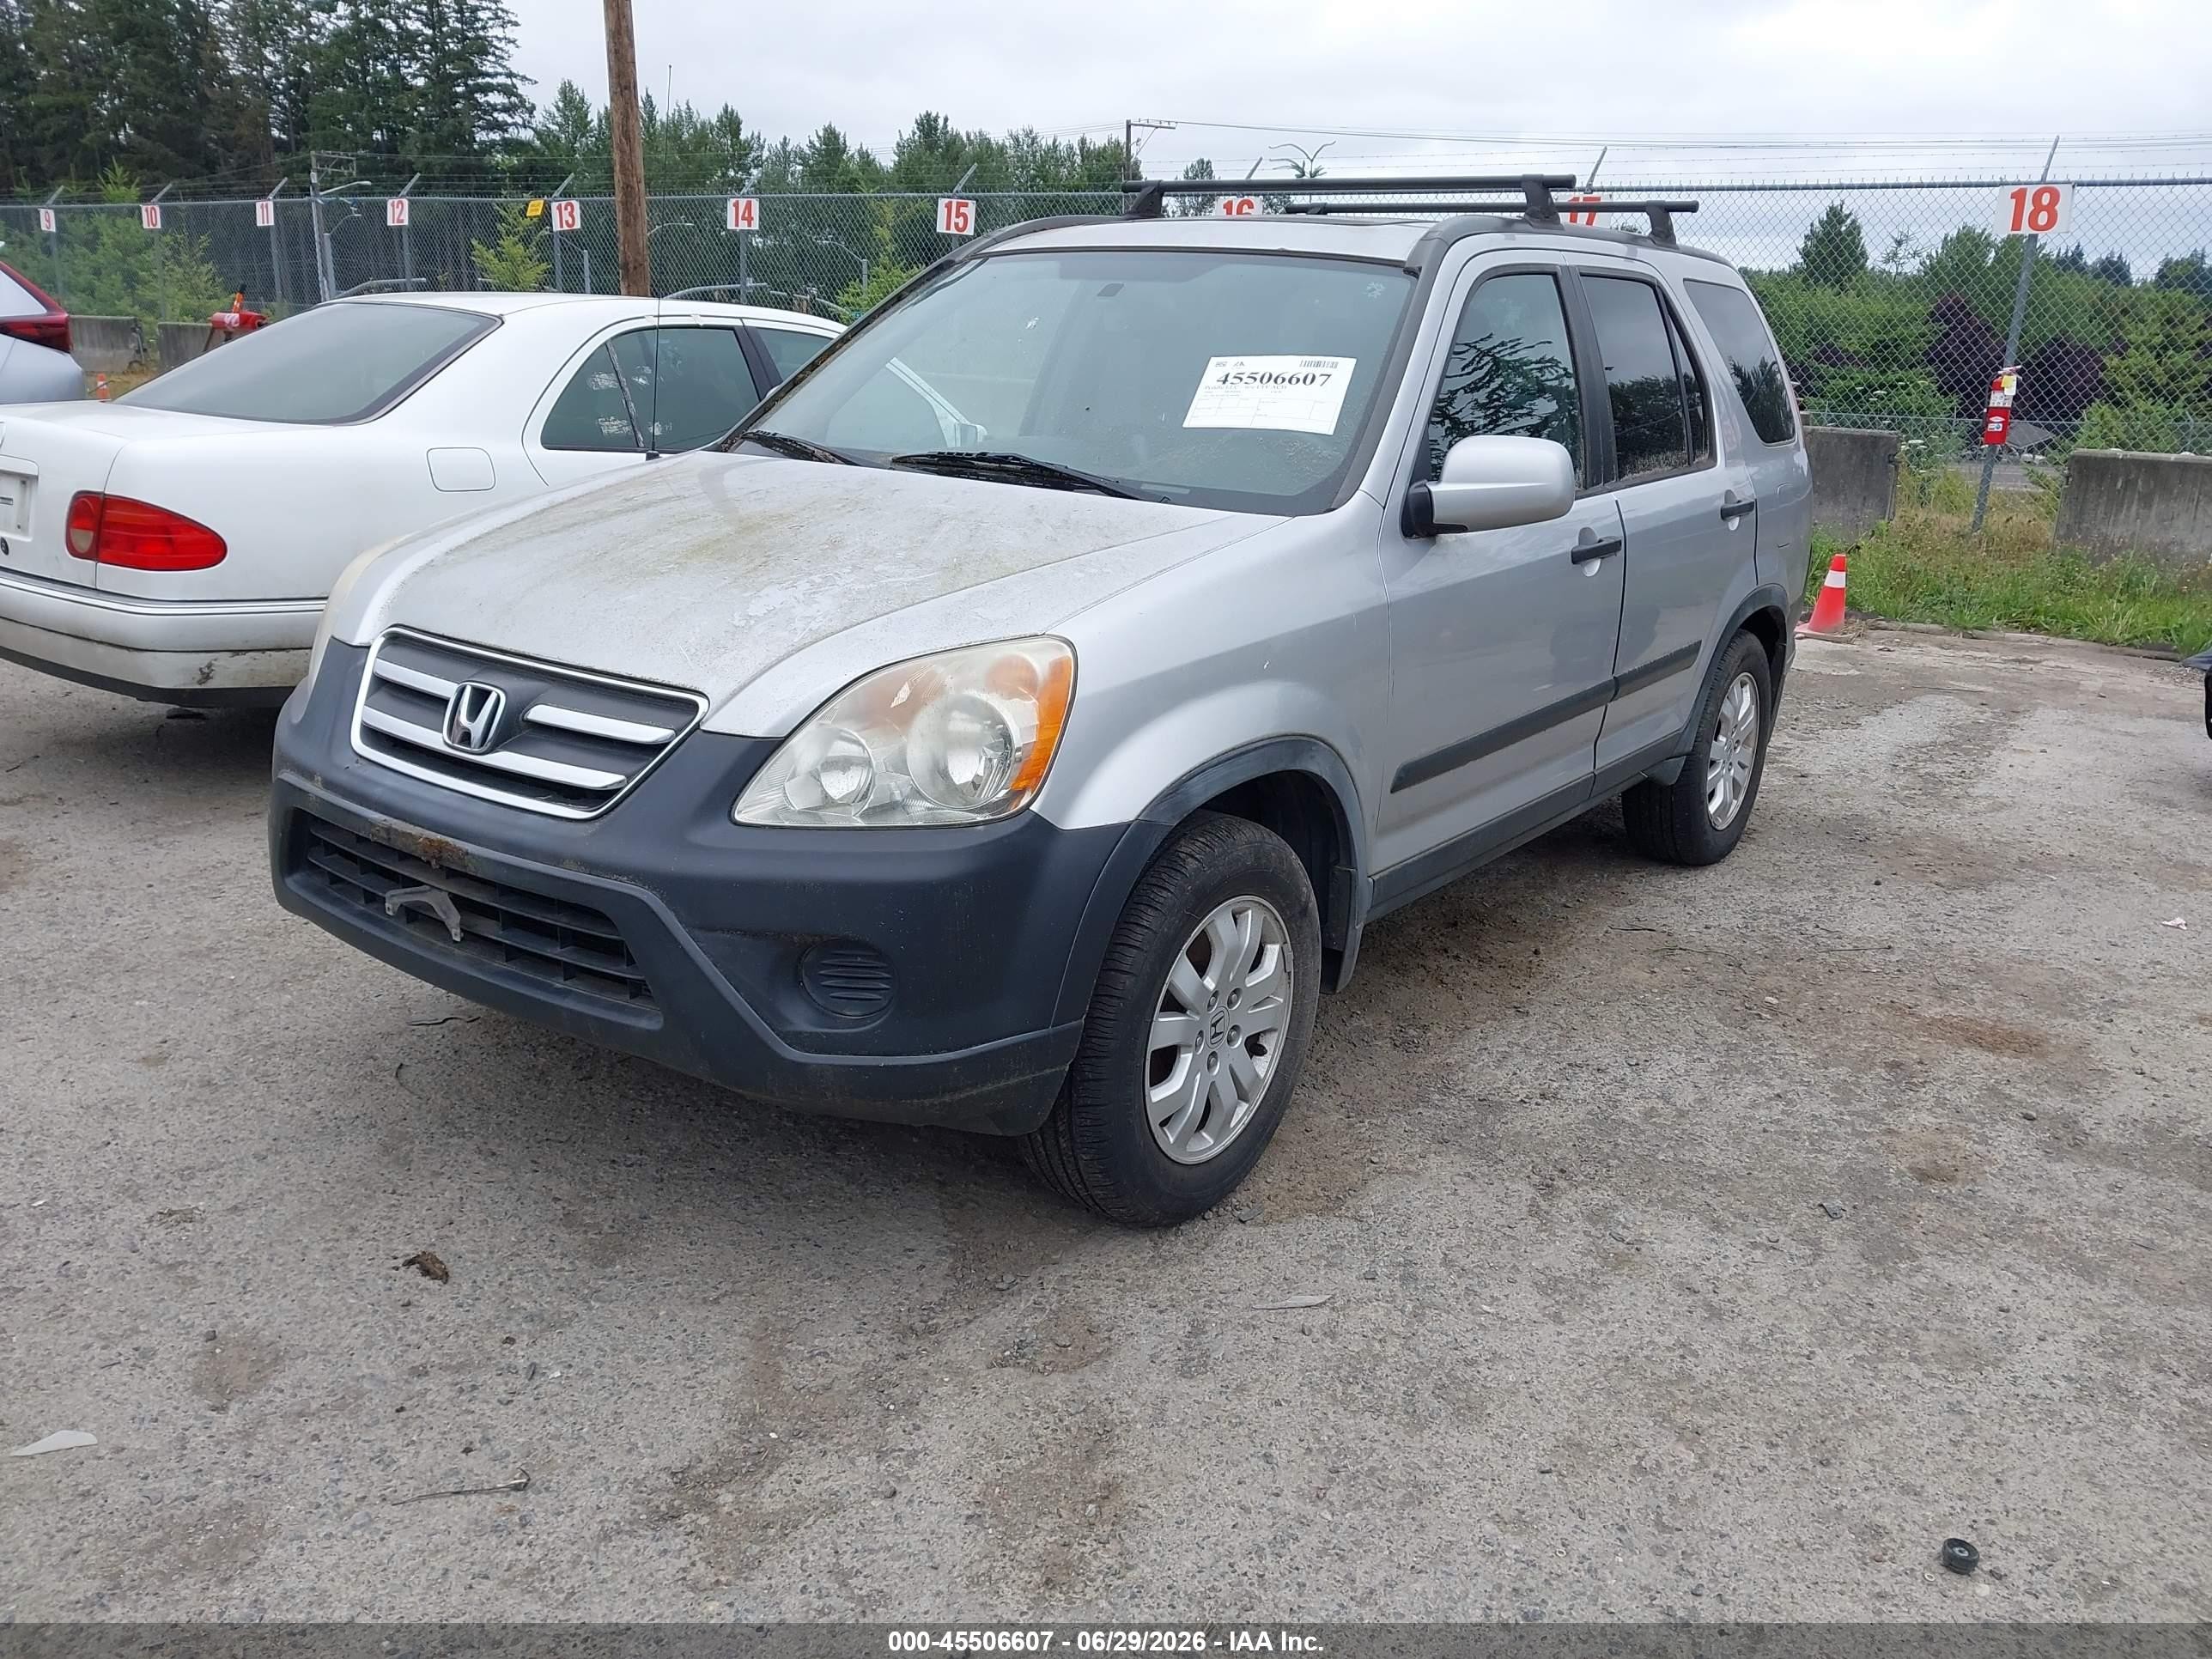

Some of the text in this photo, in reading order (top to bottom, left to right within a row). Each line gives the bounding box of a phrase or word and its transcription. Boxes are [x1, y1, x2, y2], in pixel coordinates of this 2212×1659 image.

[44, 211, 52, 229] 9
[144, 205, 158, 228] 10
[260, 201, 271, 224] 11
[390, 199, 405, 224] 12
[556, 201, 576, 229] 13
[732, 199, 754, 228] 14
[945, 200, 969, 233] 15
[2010, 185, 2061, 232] 18
[1216, 371, 1333, 387] 45506607
